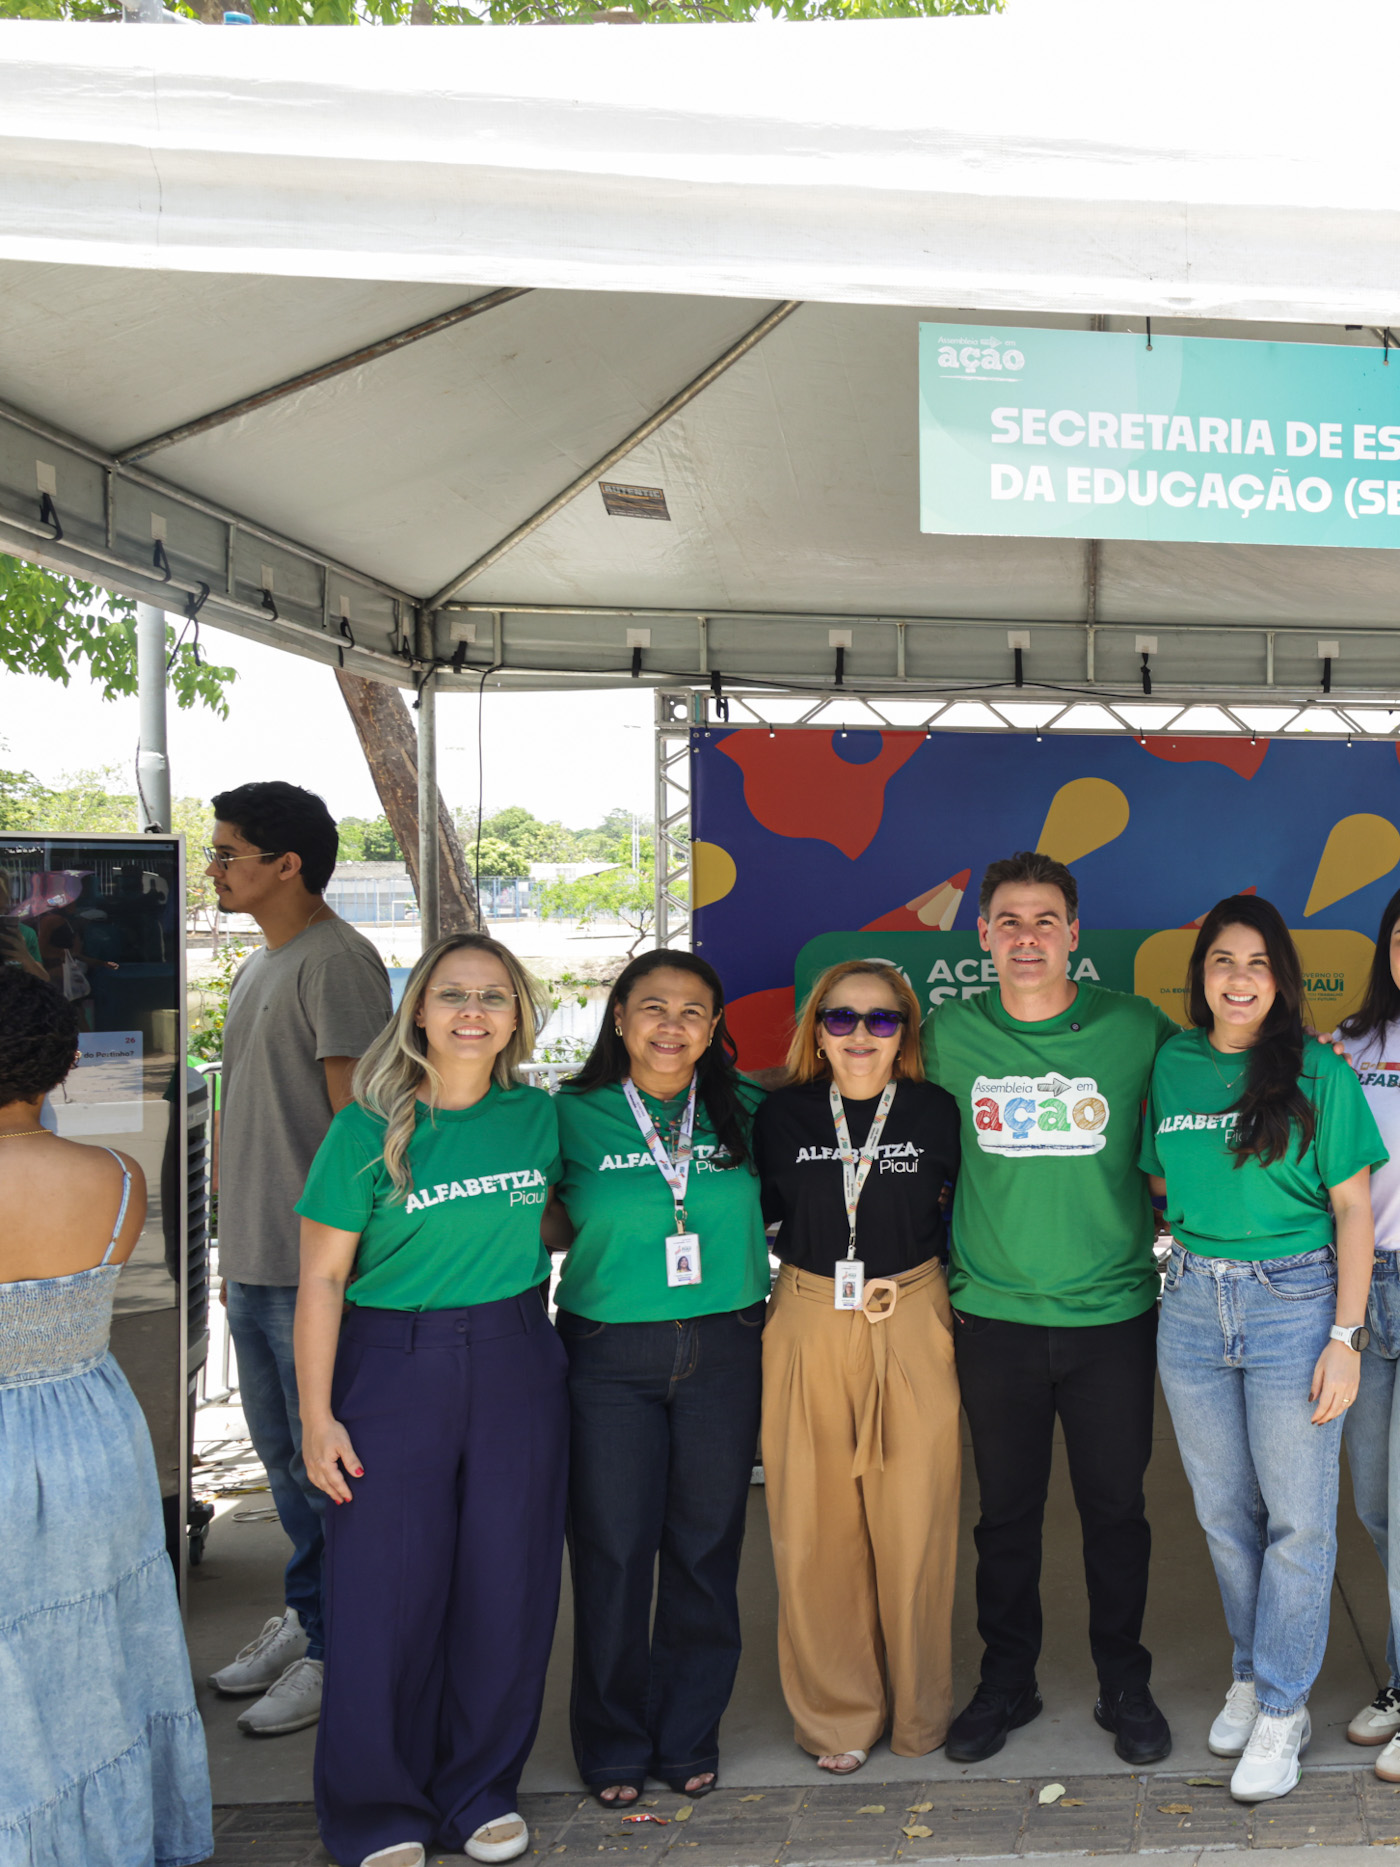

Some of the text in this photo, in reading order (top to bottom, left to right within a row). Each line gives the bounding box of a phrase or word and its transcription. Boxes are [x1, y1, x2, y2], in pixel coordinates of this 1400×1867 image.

[990, 407, 1276, 457] SECRETARIA
[1286, 420, 1343, 459] DE
[990, 463, 1056, 502] DA
[1066, 467, 1333, 519] EDUCAÇÃO
[83, 1051, 94, 1059] do
[974, 1082, 1094, 1094] Assembleia em
[879, 1158, 920, 1175] Piauí
[405, 1169, 546, 1214] ALFABETIZA
